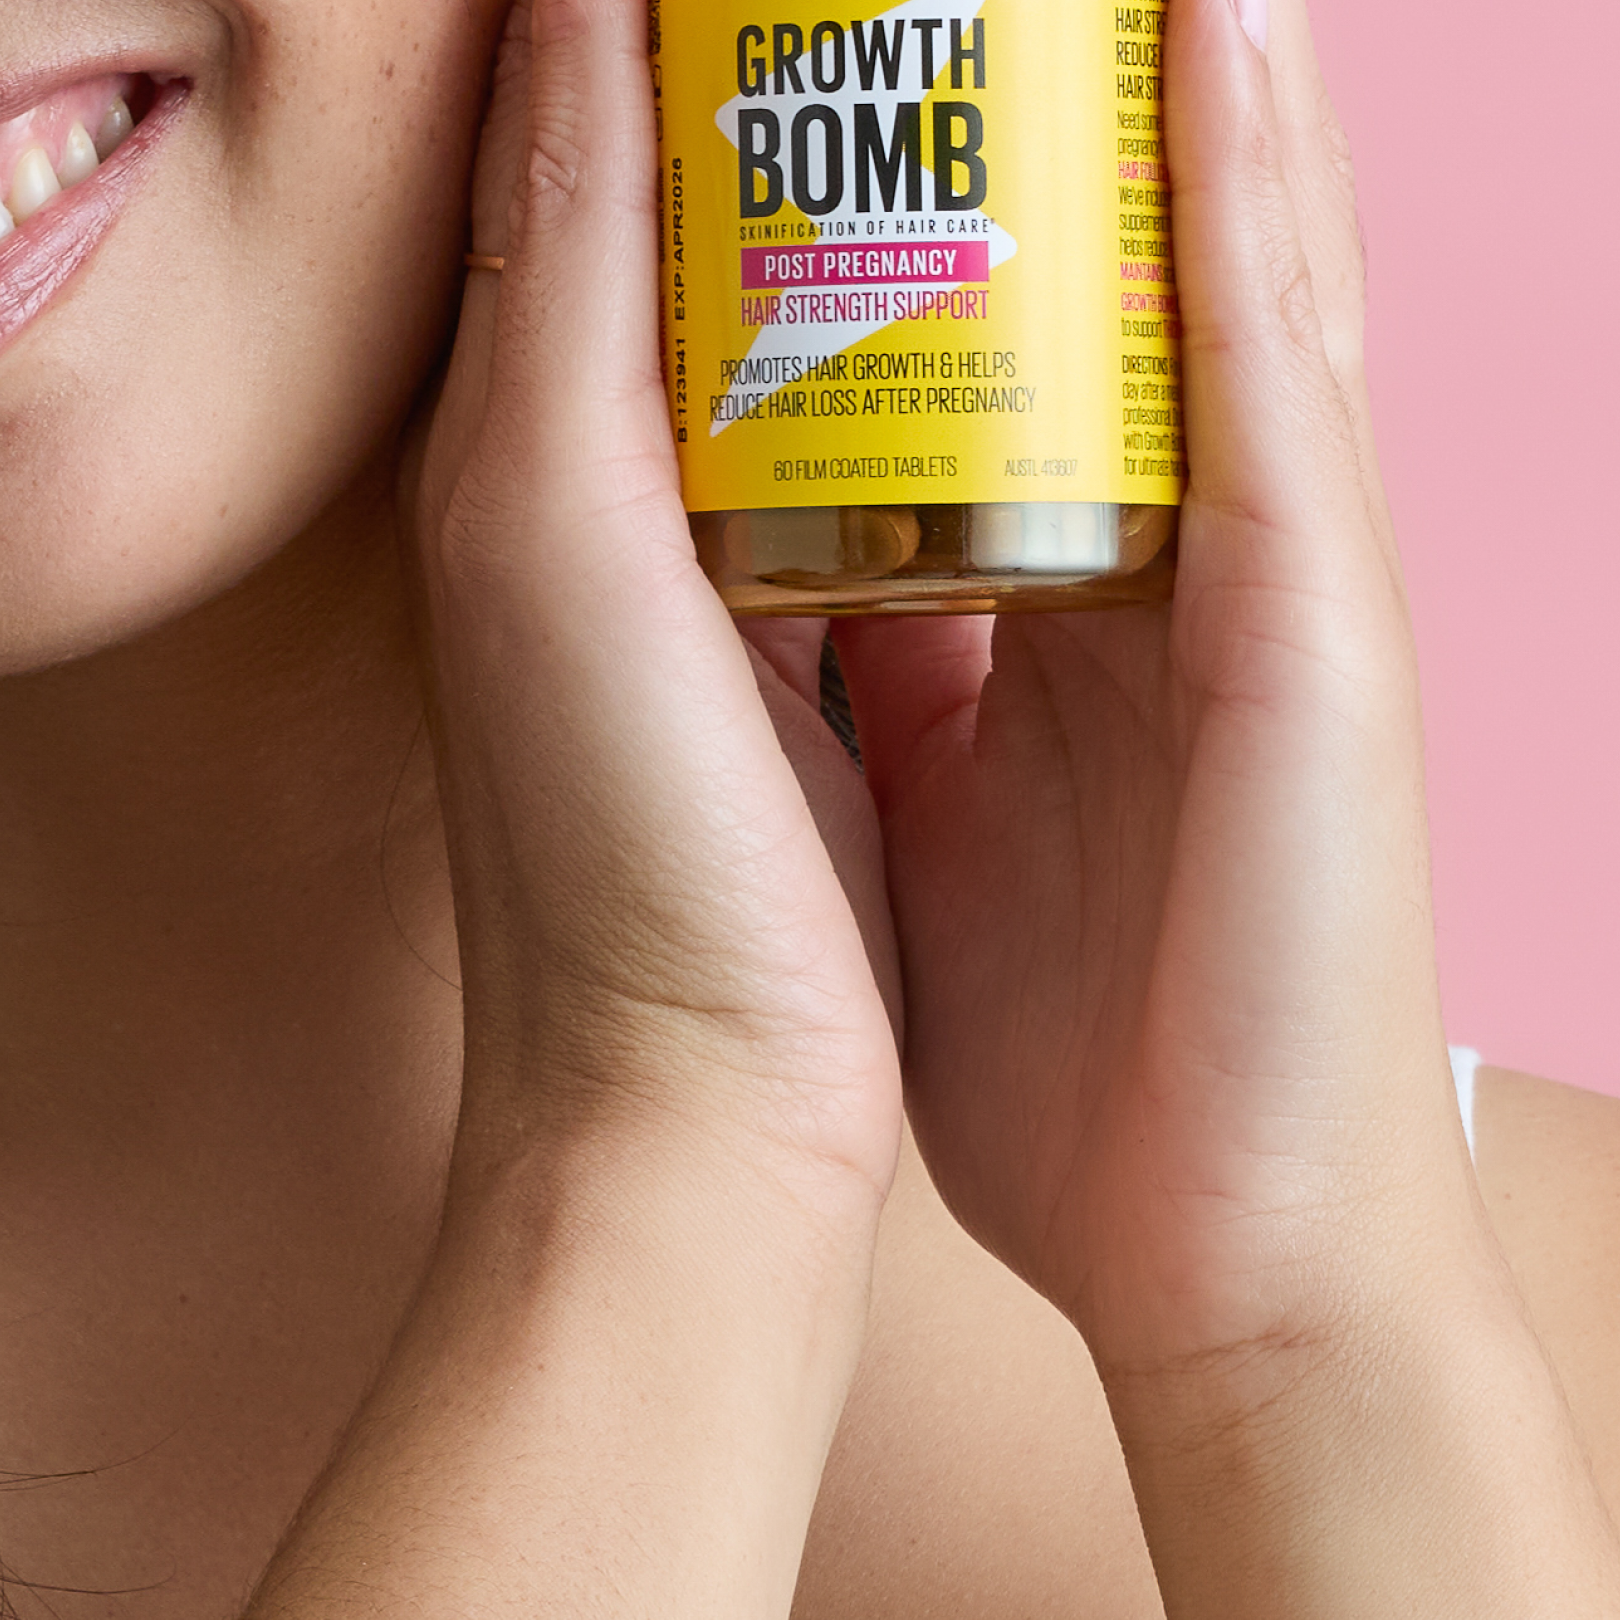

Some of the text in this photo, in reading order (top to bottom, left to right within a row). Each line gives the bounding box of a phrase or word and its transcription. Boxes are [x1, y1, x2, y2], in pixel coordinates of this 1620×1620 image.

[1115, 7, 1168, 35] HAIR STRE
[737, 18, 986, 98] GROWTH
[1116, 41, 1159, 68] REDUCE
[1117, 74, 1144, 100] HAIR
[1117, 110, 1139, 130] Need
[738, 101, 987, 218] BOMB
[1118, 161, 1139, 179] HAIR
[740, 221, 856, 241] SKINIFICATION
[867, 220, 886, 236] OF
[896, 219, 936, 235] HAIR
[765, 249, 957, 280] POST PREGNANCY
[741, 289, 989, 326] HAIR STRENGTH SUPPORT
[720, 351, 1016, 386] PROMOTES HAIR GROWTH & HELPS
[710, 386, 1037, 422] REDUCE HAIR LOSS AFTER PREGNANCY
[1122, 380, 1139, 401] day
[774, 455, 957, 482] 60 FILM COATED TABLETS
